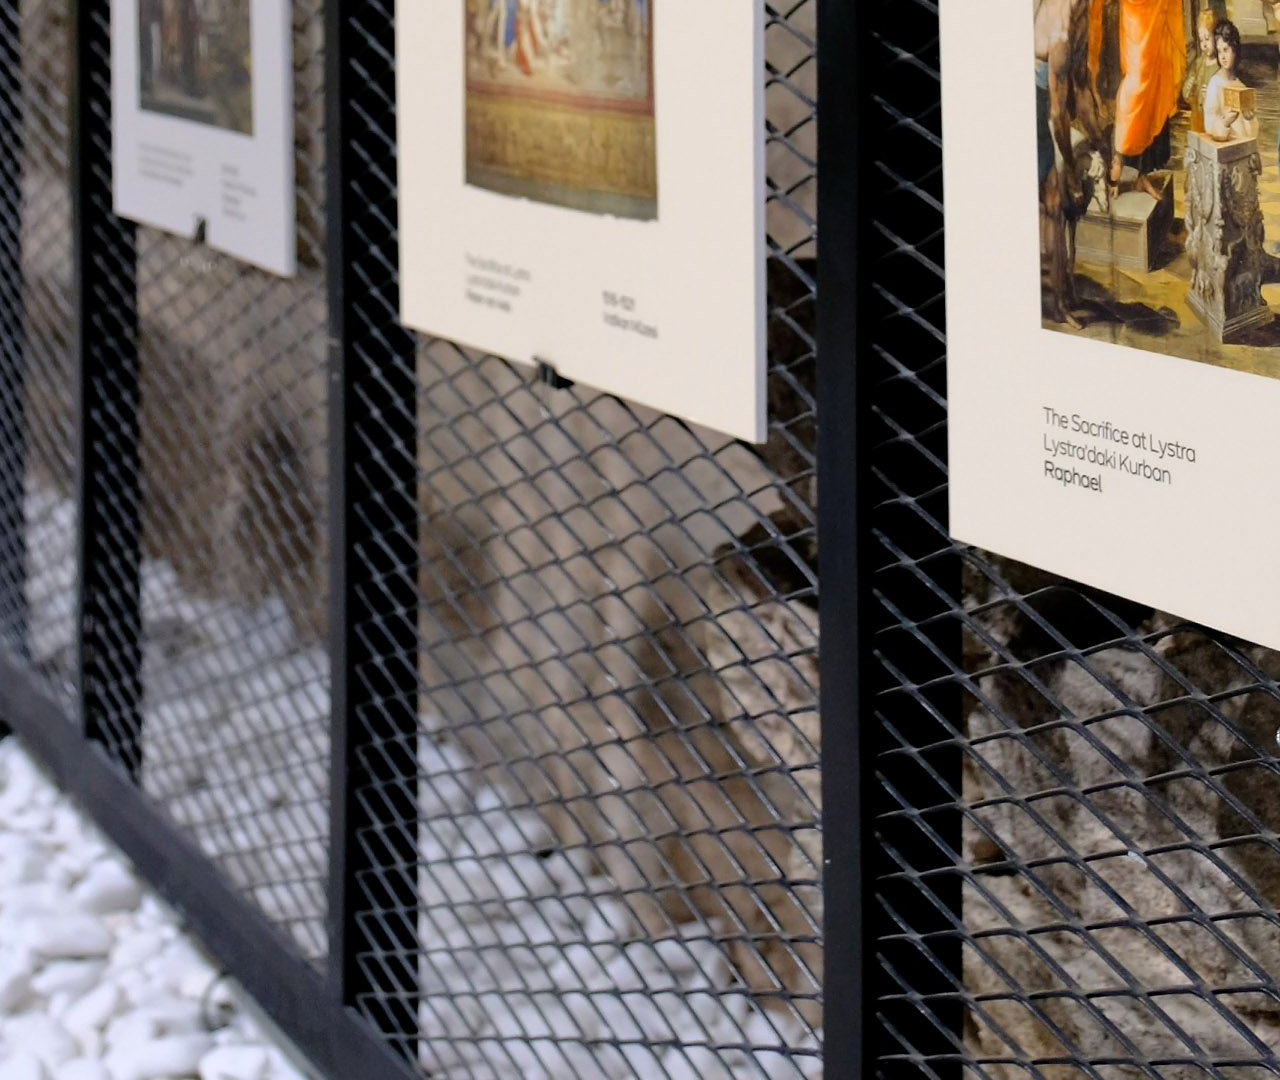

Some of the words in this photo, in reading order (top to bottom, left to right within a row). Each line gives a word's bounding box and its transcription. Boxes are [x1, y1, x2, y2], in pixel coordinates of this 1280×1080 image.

[1042, 406, 1069, 429] The
[1071, 414, 1130, 445] Sacrifice
[1132, 432, 1147, 450] at
[1149, 433, 1196, 463] Lystra
[1043, 433, 1116, 469] Lystra'daki
[1119, 454, 1172, 484] Kurban
[1044, 460, 1103, 492] Raphael
